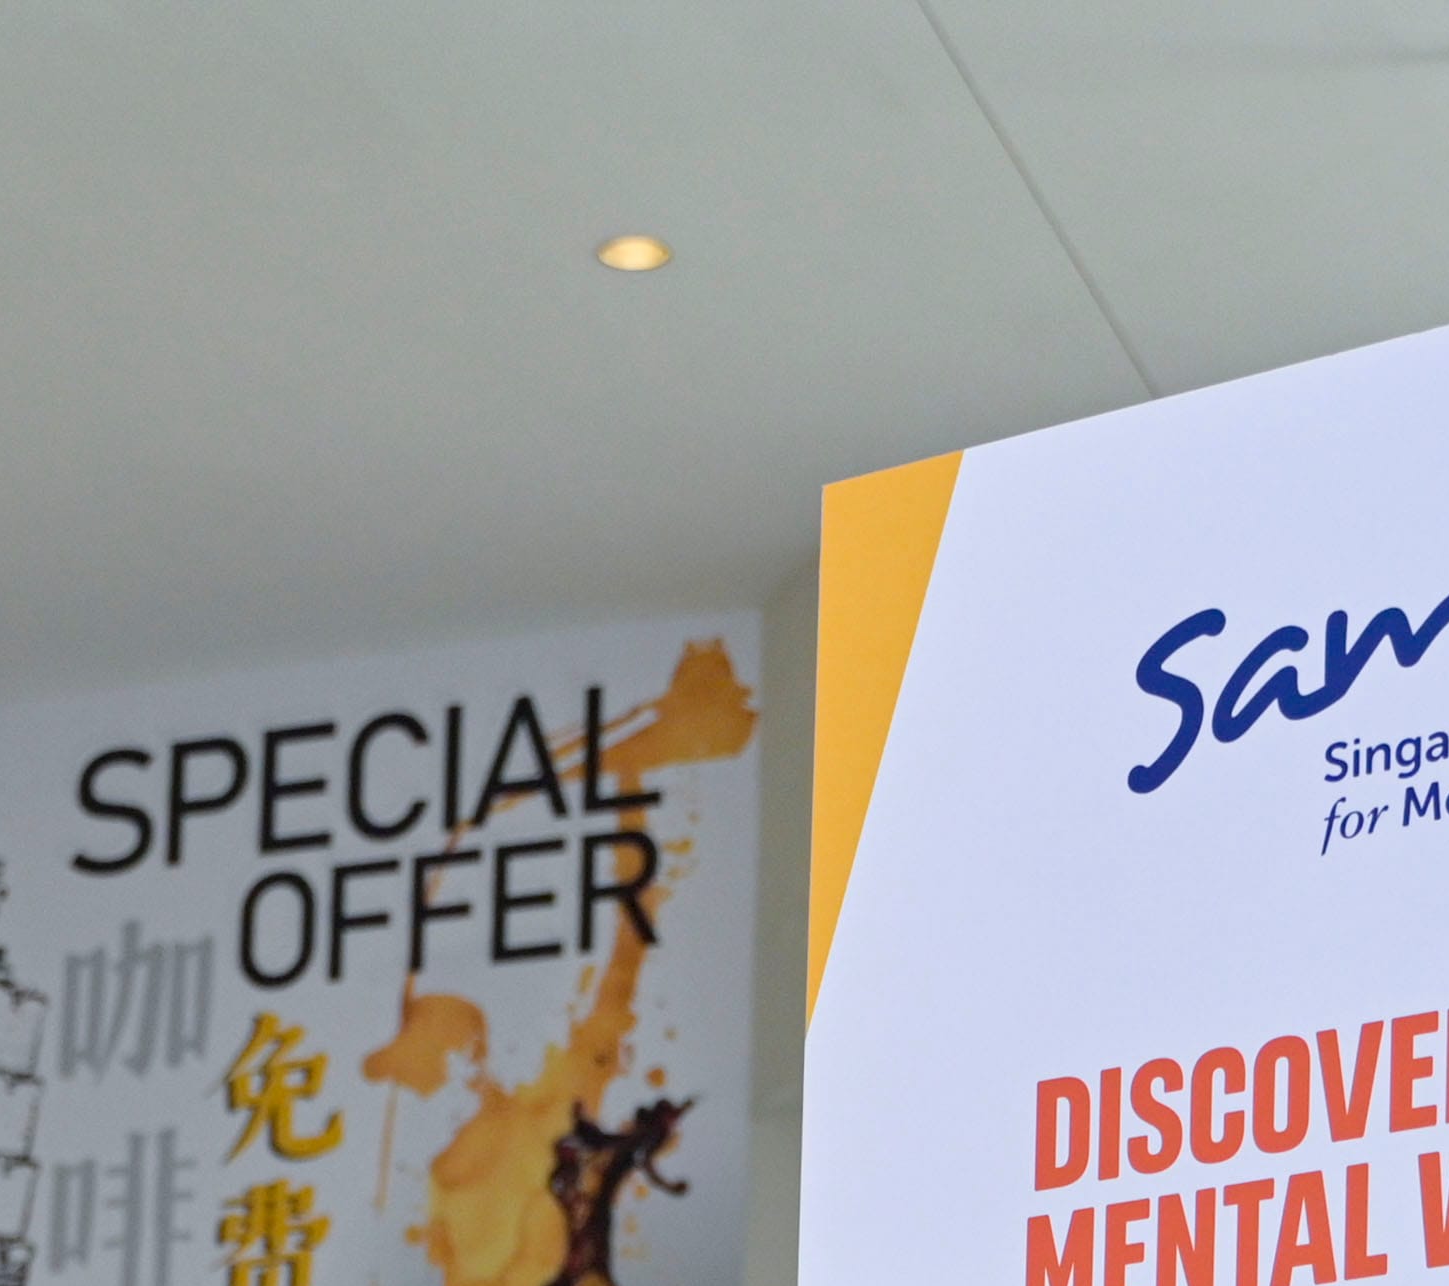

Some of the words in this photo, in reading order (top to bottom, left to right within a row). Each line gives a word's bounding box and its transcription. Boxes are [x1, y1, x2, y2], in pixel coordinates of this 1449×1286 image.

[72, 686, 663, 876] SPECIAL
[1320, 796, 1390, 856] for
[238, 829, 660, 991] OFFER
